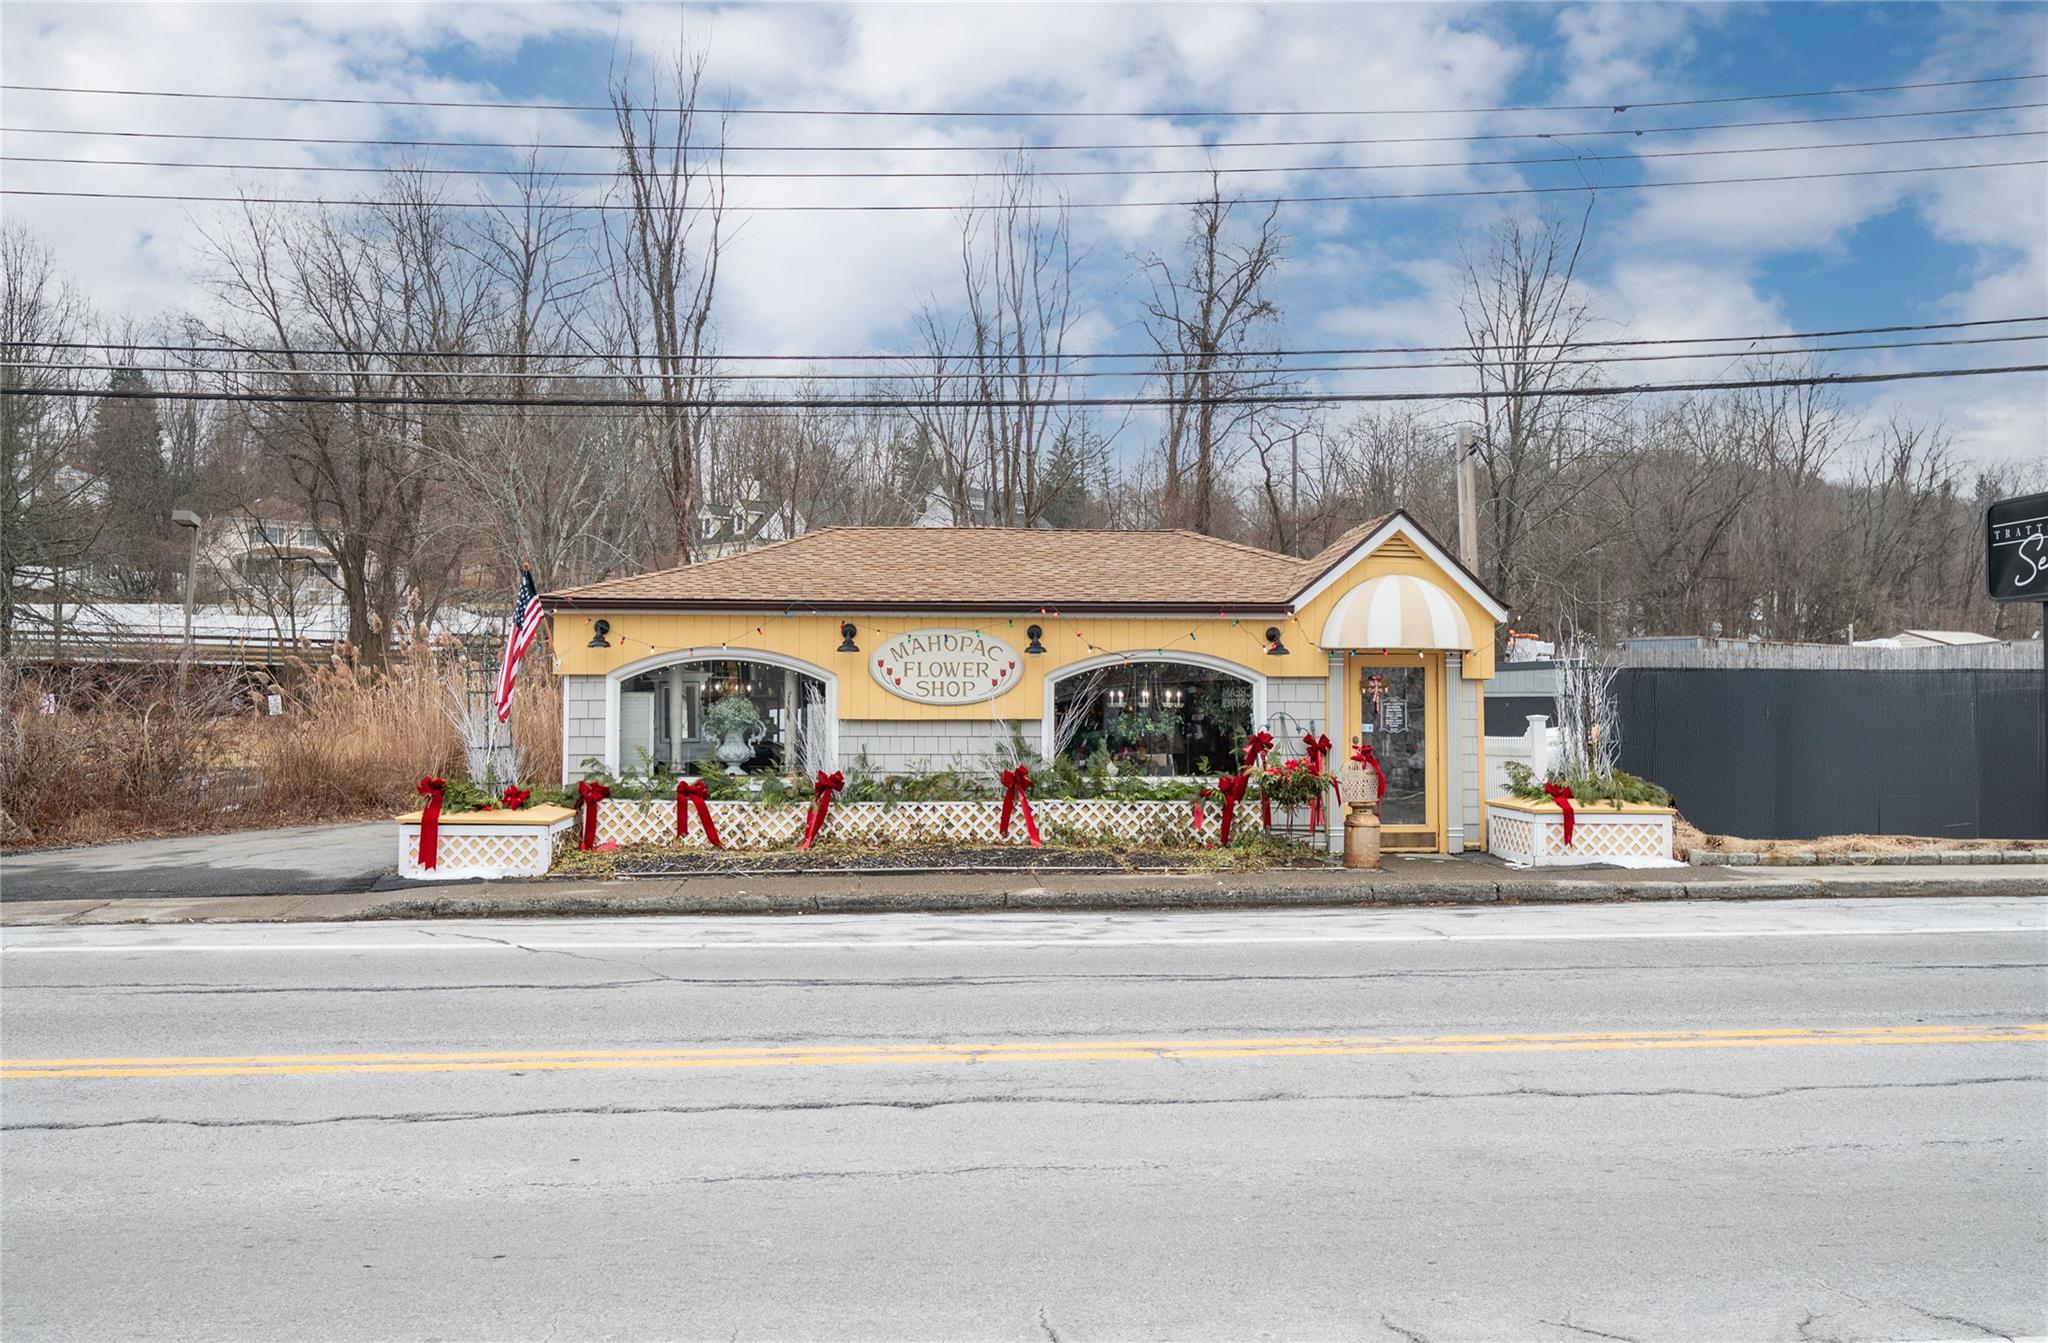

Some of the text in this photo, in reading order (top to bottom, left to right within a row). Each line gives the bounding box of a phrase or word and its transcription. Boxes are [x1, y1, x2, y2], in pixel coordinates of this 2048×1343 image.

[1994, 523, 2048, 540] TRATT
[889, 634, 1003, 663] MAHOPAC
[903, 661, 989, 678] FLOWER
[915, 680, 976, 698] SHOP
